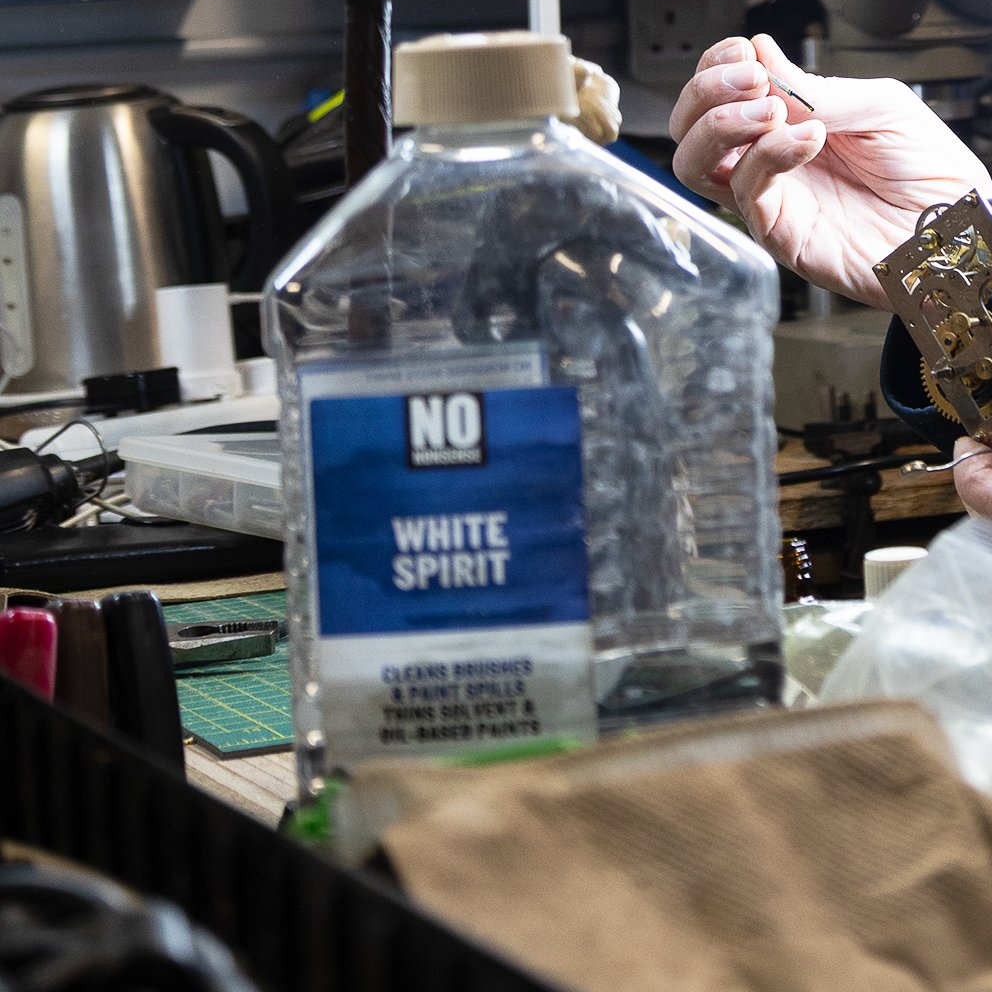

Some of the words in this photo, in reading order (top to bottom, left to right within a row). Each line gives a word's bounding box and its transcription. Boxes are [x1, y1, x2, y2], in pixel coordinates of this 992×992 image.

[408, 393, 482, 449] NO
[392, 512, 509, 554] WHITE
[392, 550, 511, 591] SPIRIT
